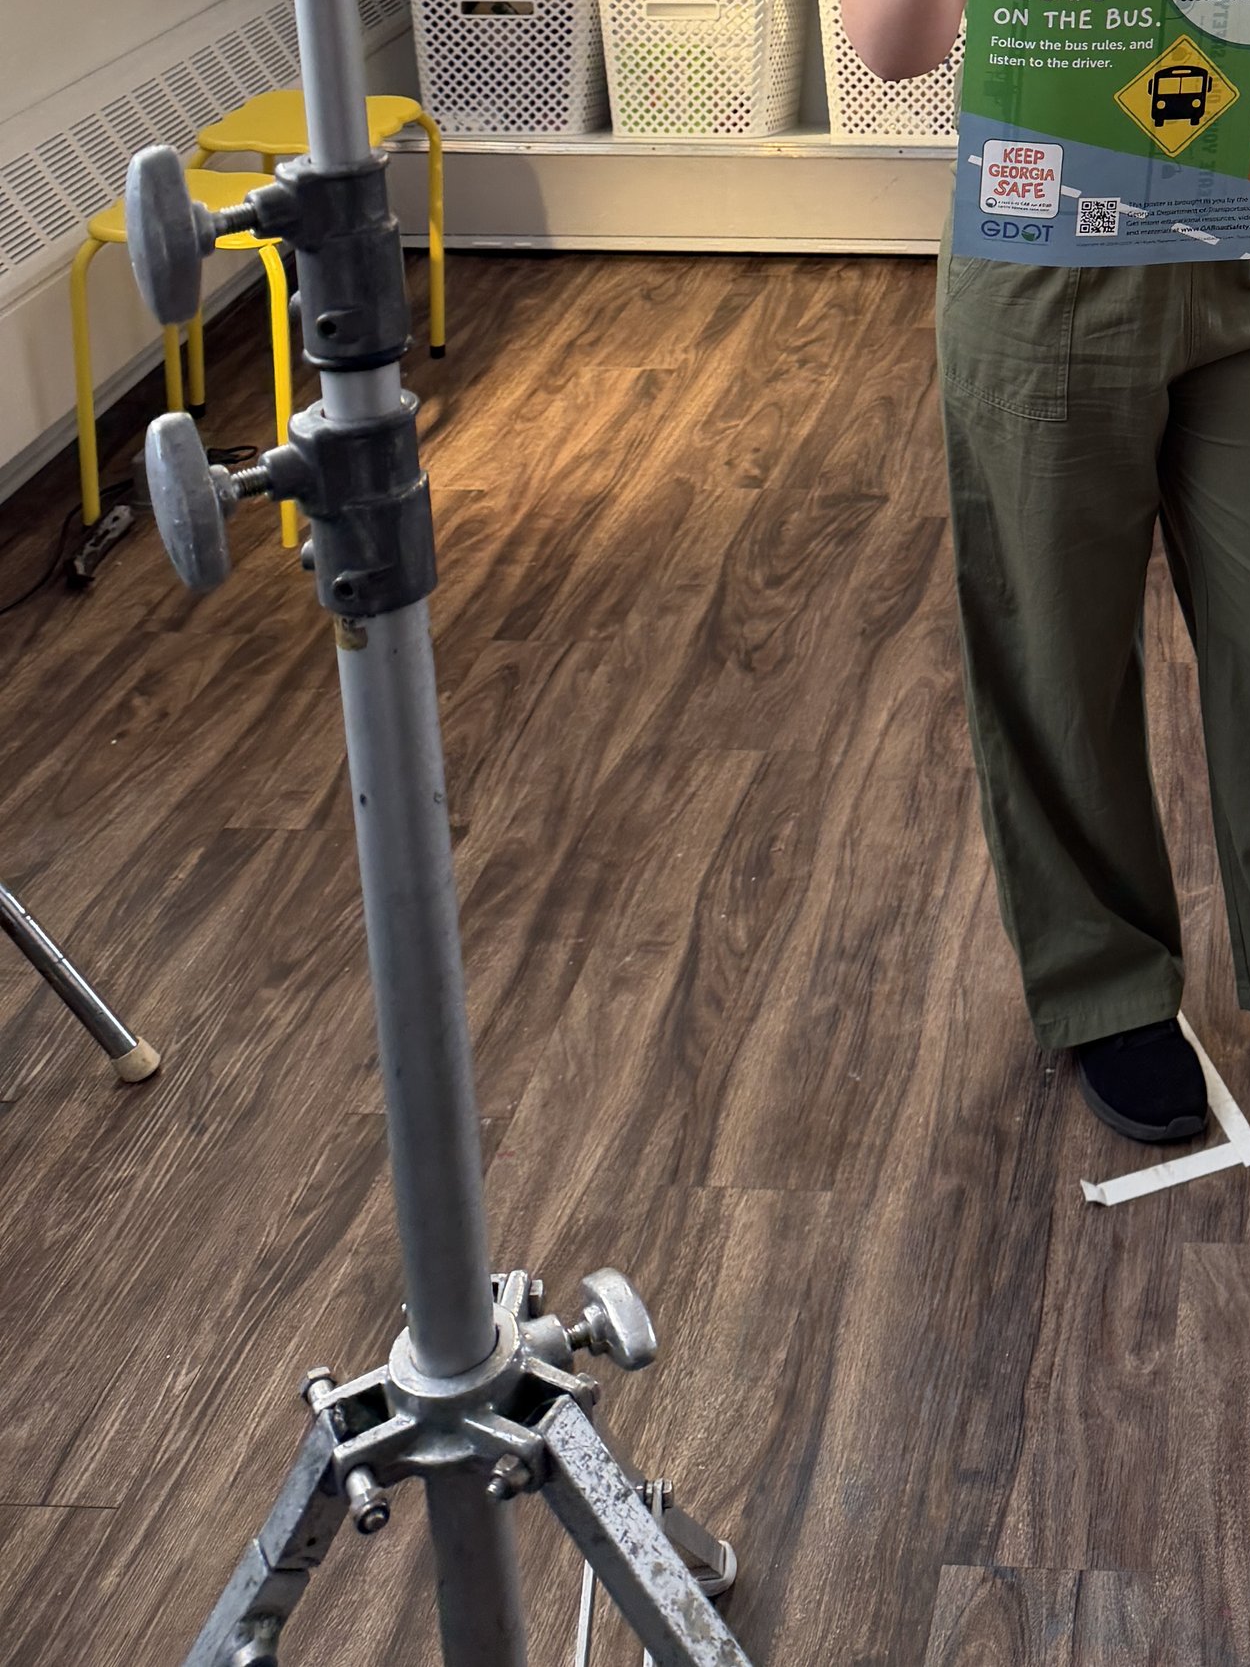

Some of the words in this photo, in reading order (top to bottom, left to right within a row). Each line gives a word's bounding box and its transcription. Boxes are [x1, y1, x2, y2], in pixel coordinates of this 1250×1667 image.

[993, 8, 1029, 26] ON
[1043, 9, 1093, 30] THE
[1106, 7, 1161, 30] BUS.
[991, 36, 1036, 50] Follow
[1039, 39, 1062, 50] the
[1065, 39, 1089, 50] bus
[1092, 39, 1126, 51] rules,
[1129, 38, 1154, 49] and
[989, 54, 1026, 66] listen
[1029, 57, 1044, 67] to
[1047, 57, 1069, 68] the
[1072, 57, 1113, 68] driver.
[1003, 147, 1045, 165] KEEP
[988, 163, 1055, 181] GEORGIA
[993, 179, 1046, 199] SAFE
[981, 220, 1054, 242] GDOT
